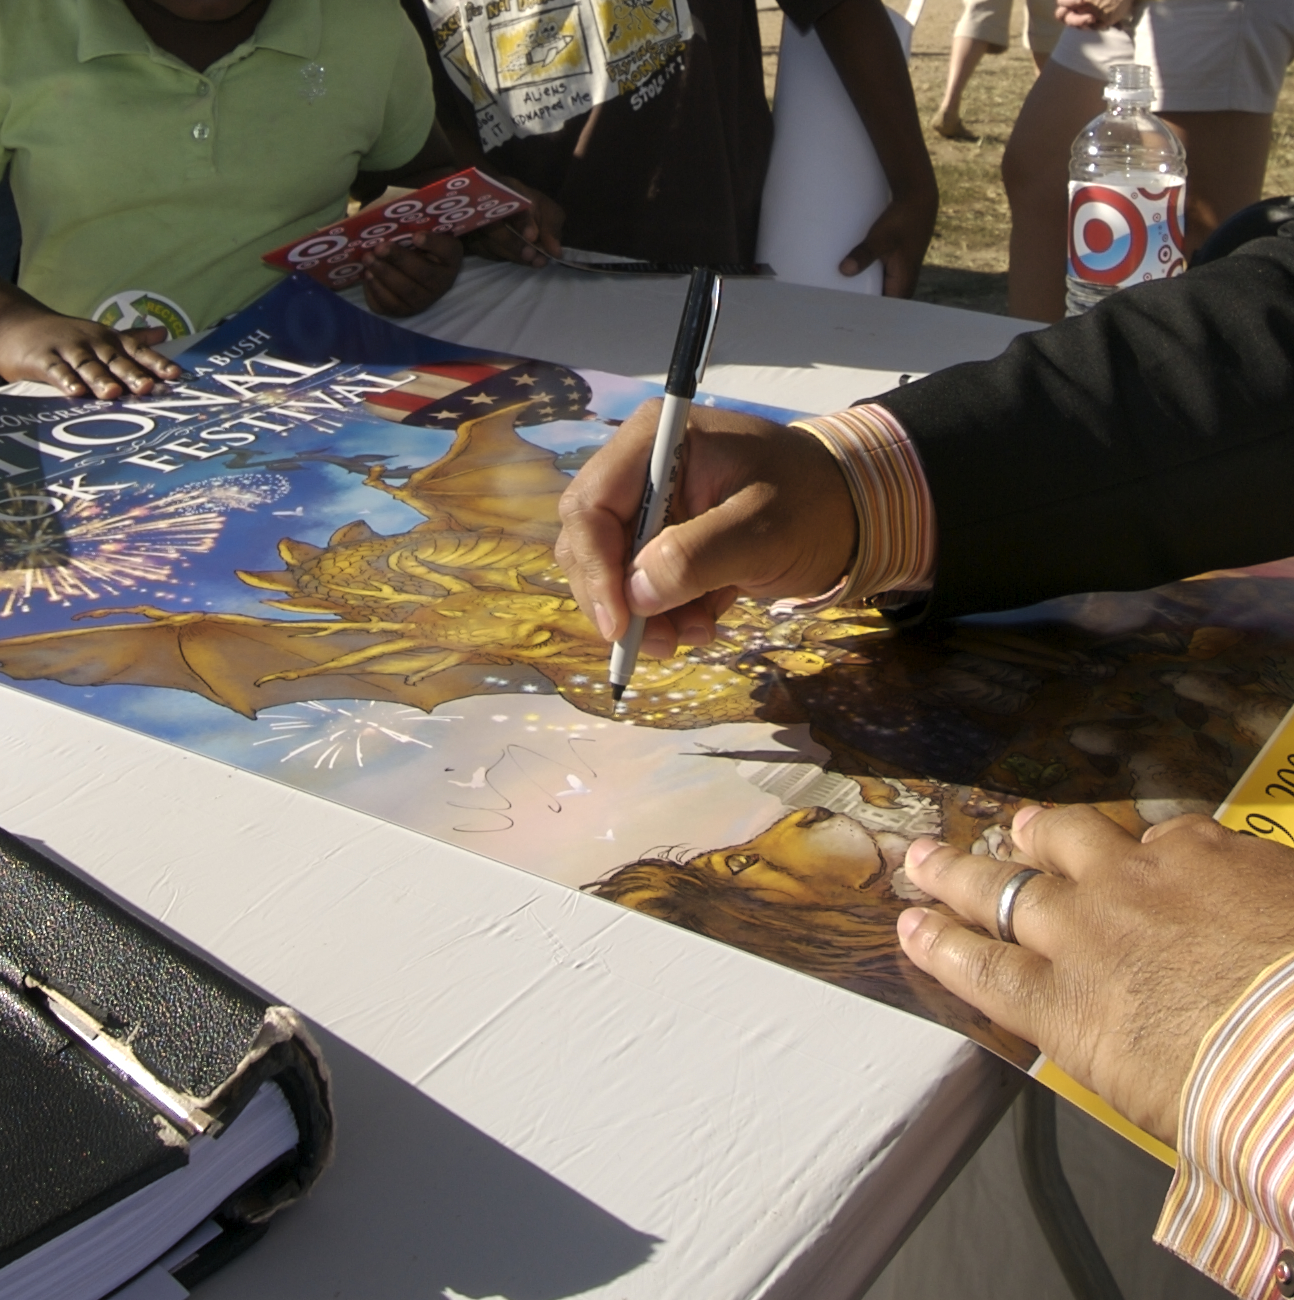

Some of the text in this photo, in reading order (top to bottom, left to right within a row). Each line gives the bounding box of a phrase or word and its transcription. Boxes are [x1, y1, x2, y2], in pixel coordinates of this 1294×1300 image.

[630, 74, 665, 112] STOLE
[146, 301, 185, 337] RECYCL
[207, 328, 272, 368] BUSH
[121, 372, 417, 474] FESTIVAL
